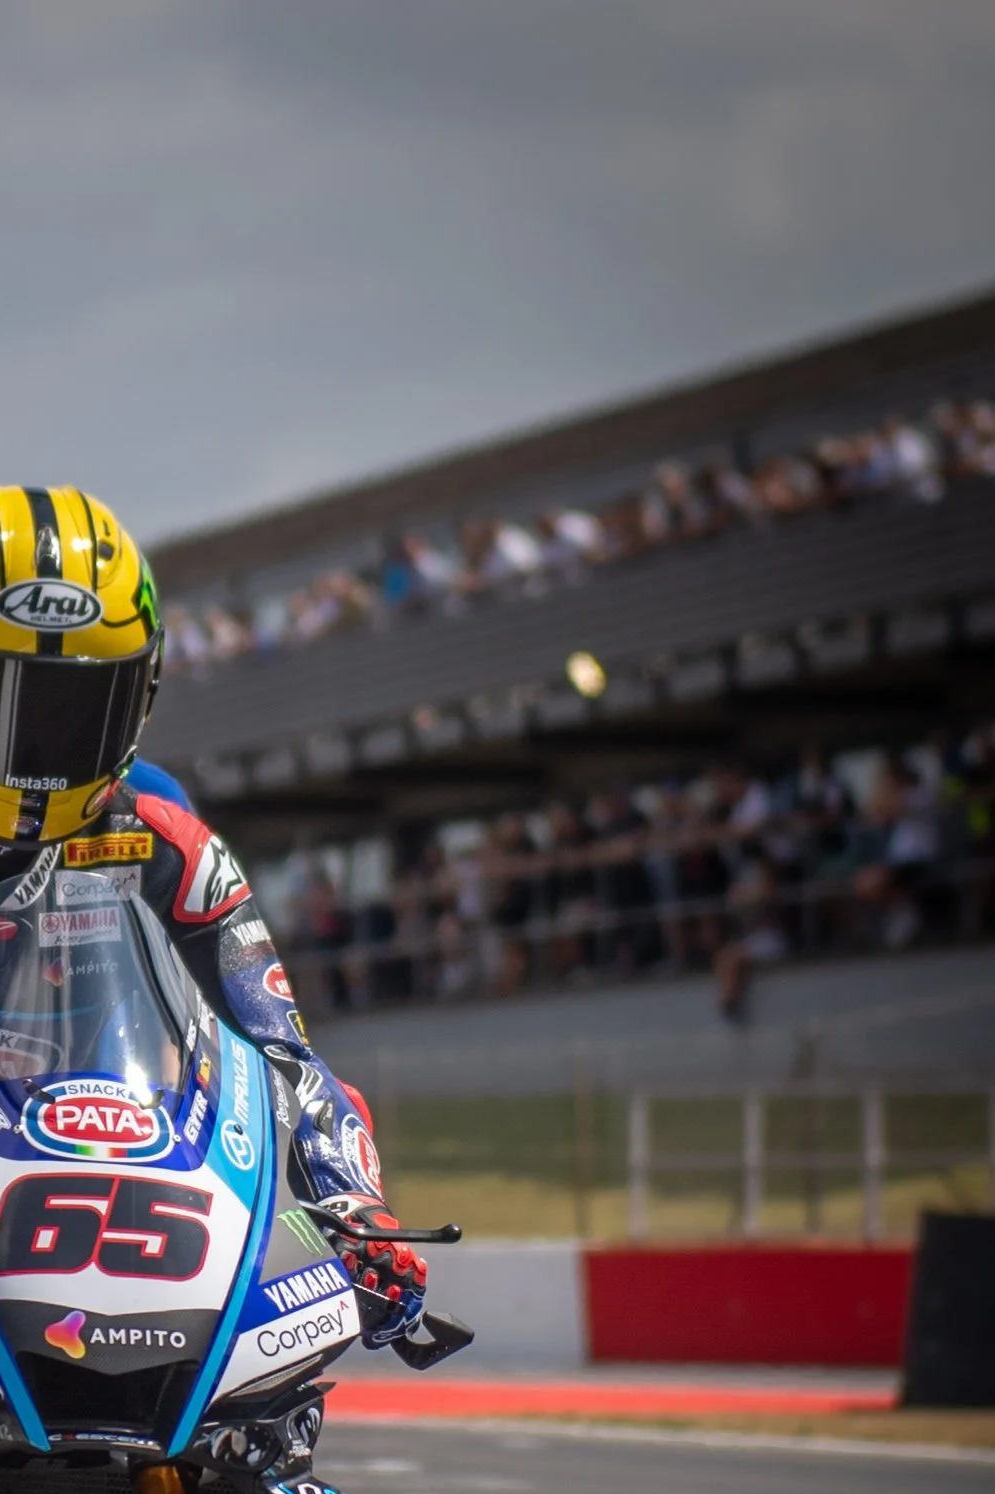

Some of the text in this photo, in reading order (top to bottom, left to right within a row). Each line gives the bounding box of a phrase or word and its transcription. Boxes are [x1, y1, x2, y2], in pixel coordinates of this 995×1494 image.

[4, 585, 90, 616] Arai
[5, 773, 67, 791] Insta360
[66, 837, 148, 862] PIRELLI
[61, 908, 118, 931] YAMAHA
[68, 1084, 129, 1098] SNACK
[55, 1105, 144, 1137] PATA
[263, 1263, 348, 1313] YAMAHA
[90, 1327, 187, 1348] AMPITO
